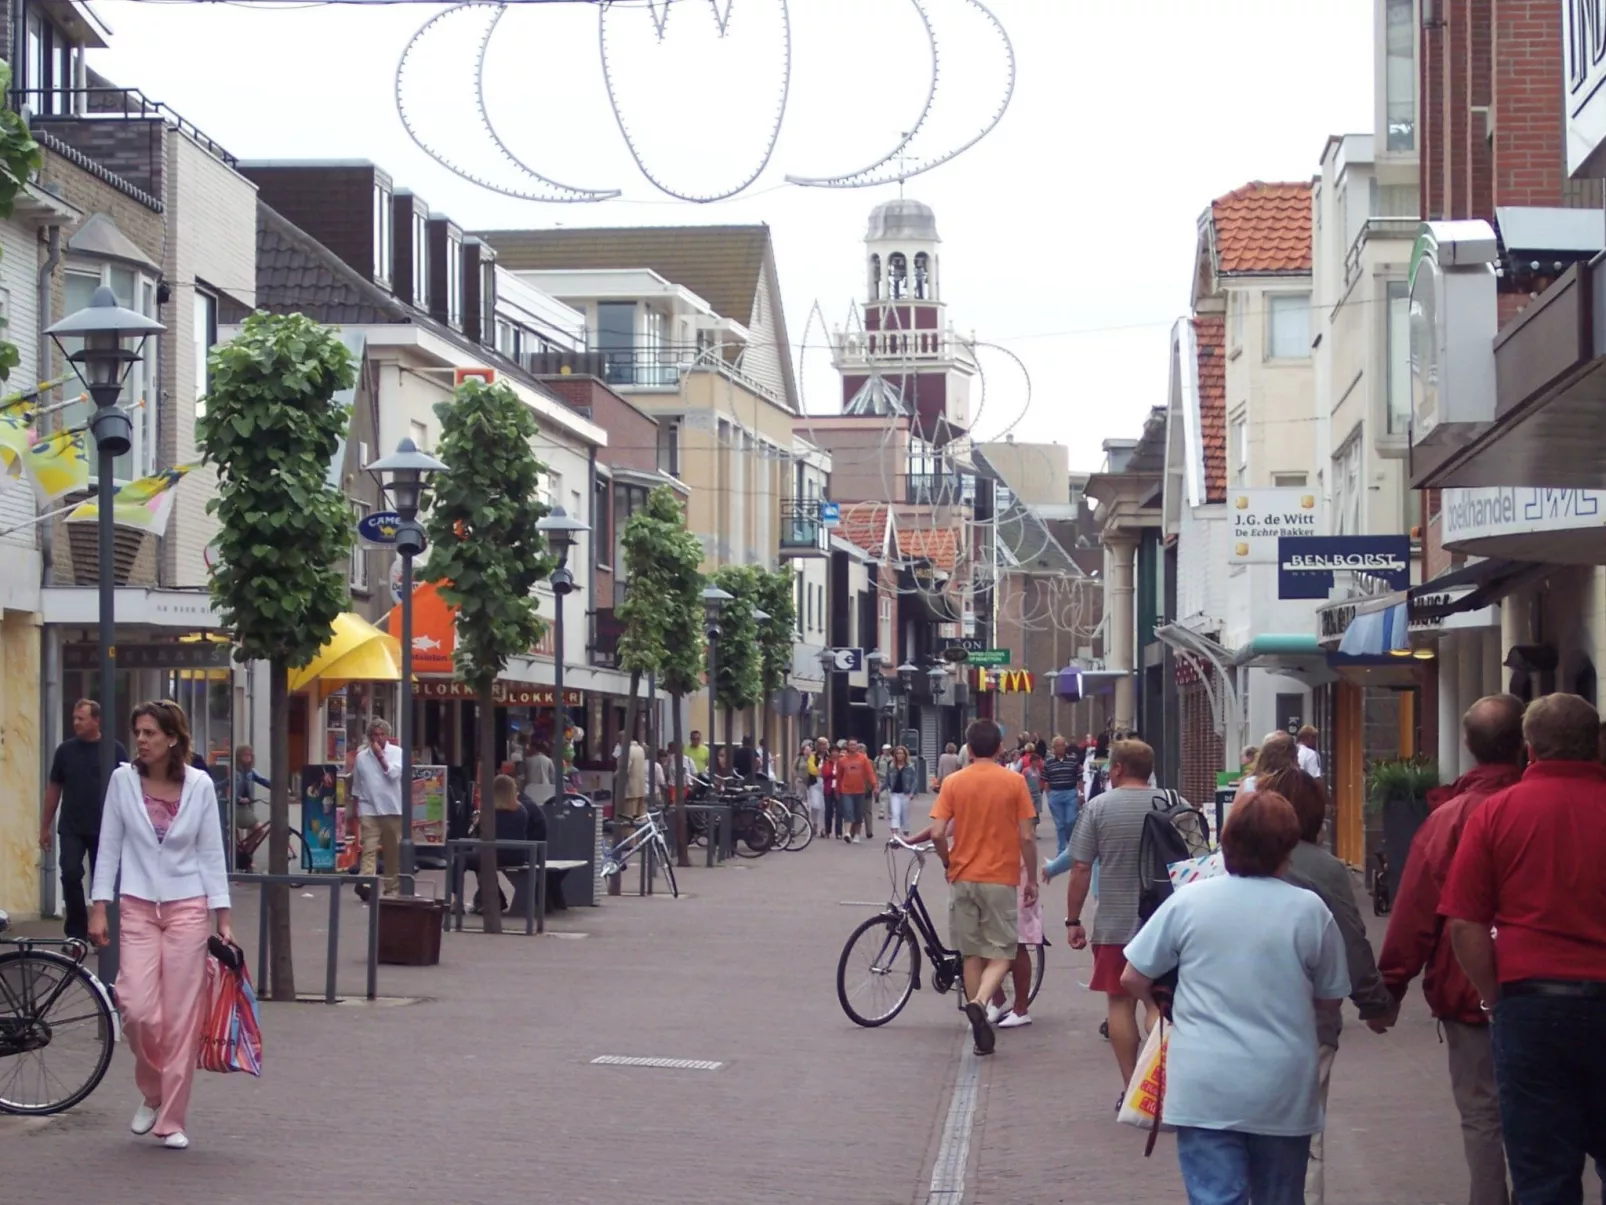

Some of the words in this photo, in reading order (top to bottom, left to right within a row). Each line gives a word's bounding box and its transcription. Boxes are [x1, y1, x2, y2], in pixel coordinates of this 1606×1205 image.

[368, 516, 402, 527] CAME
[1234, 514, 1260, 526] J.G.
[1264, 513, 1280, 525] de
[1284, 513, 1314, 525] Witt
[1235, 529, 1248, 537] De
[1250, 527, 1278, 537] Echte
[1280, 527, 1314, 536] Bakker
[1290, 554, 1329, 566] BEN
[1332, 553, 1397, 566] BORST
[945, 640, 982, 649] LON
[68, 650, 221, 663] MAELAARS
[411, 682, 501, 696] BLOKKR
[505, 692, 580, 703] LOKKR
